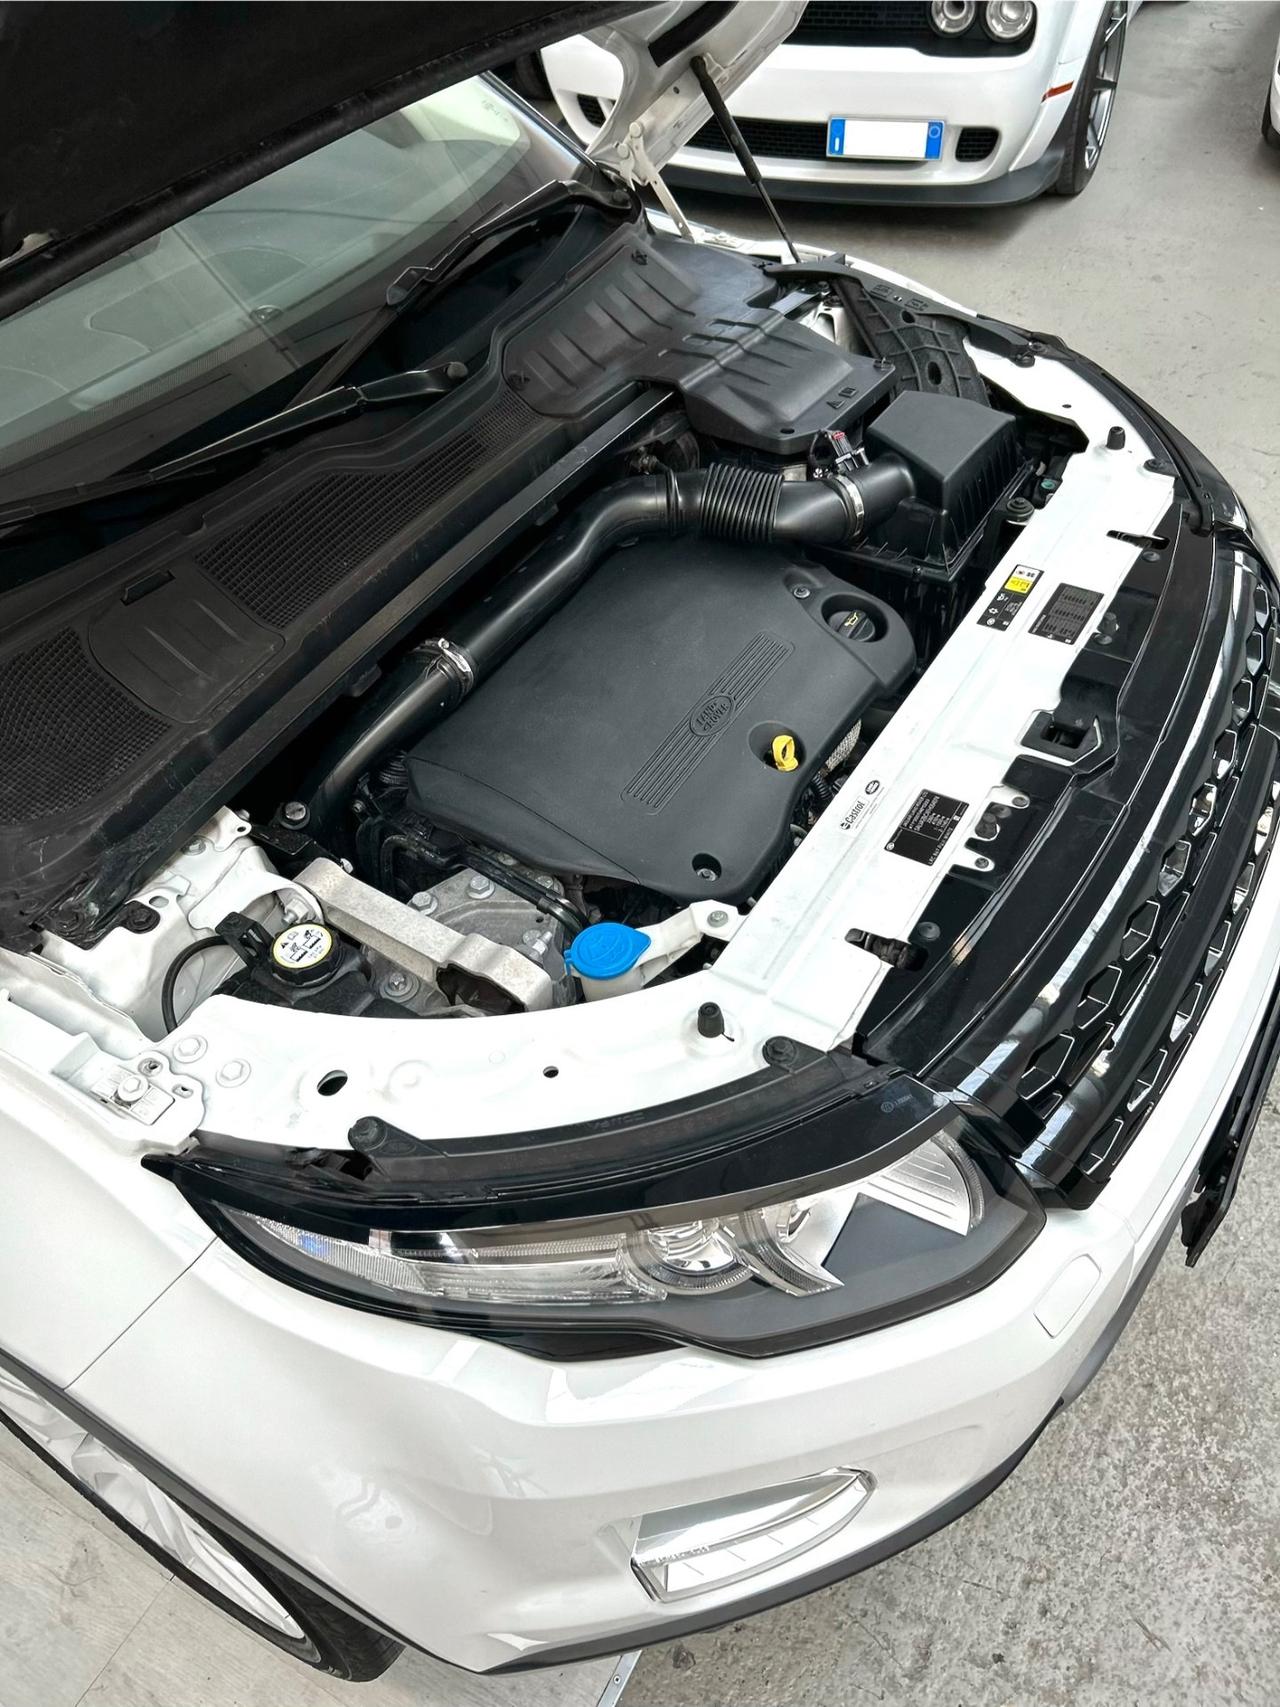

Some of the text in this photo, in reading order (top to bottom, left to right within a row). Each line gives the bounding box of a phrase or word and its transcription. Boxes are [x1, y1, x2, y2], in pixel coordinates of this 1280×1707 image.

[696, 702, 718, 725] LAND
[702, 703, 729, 731] ROVER
[844, 800, 866, 825] Castrol
